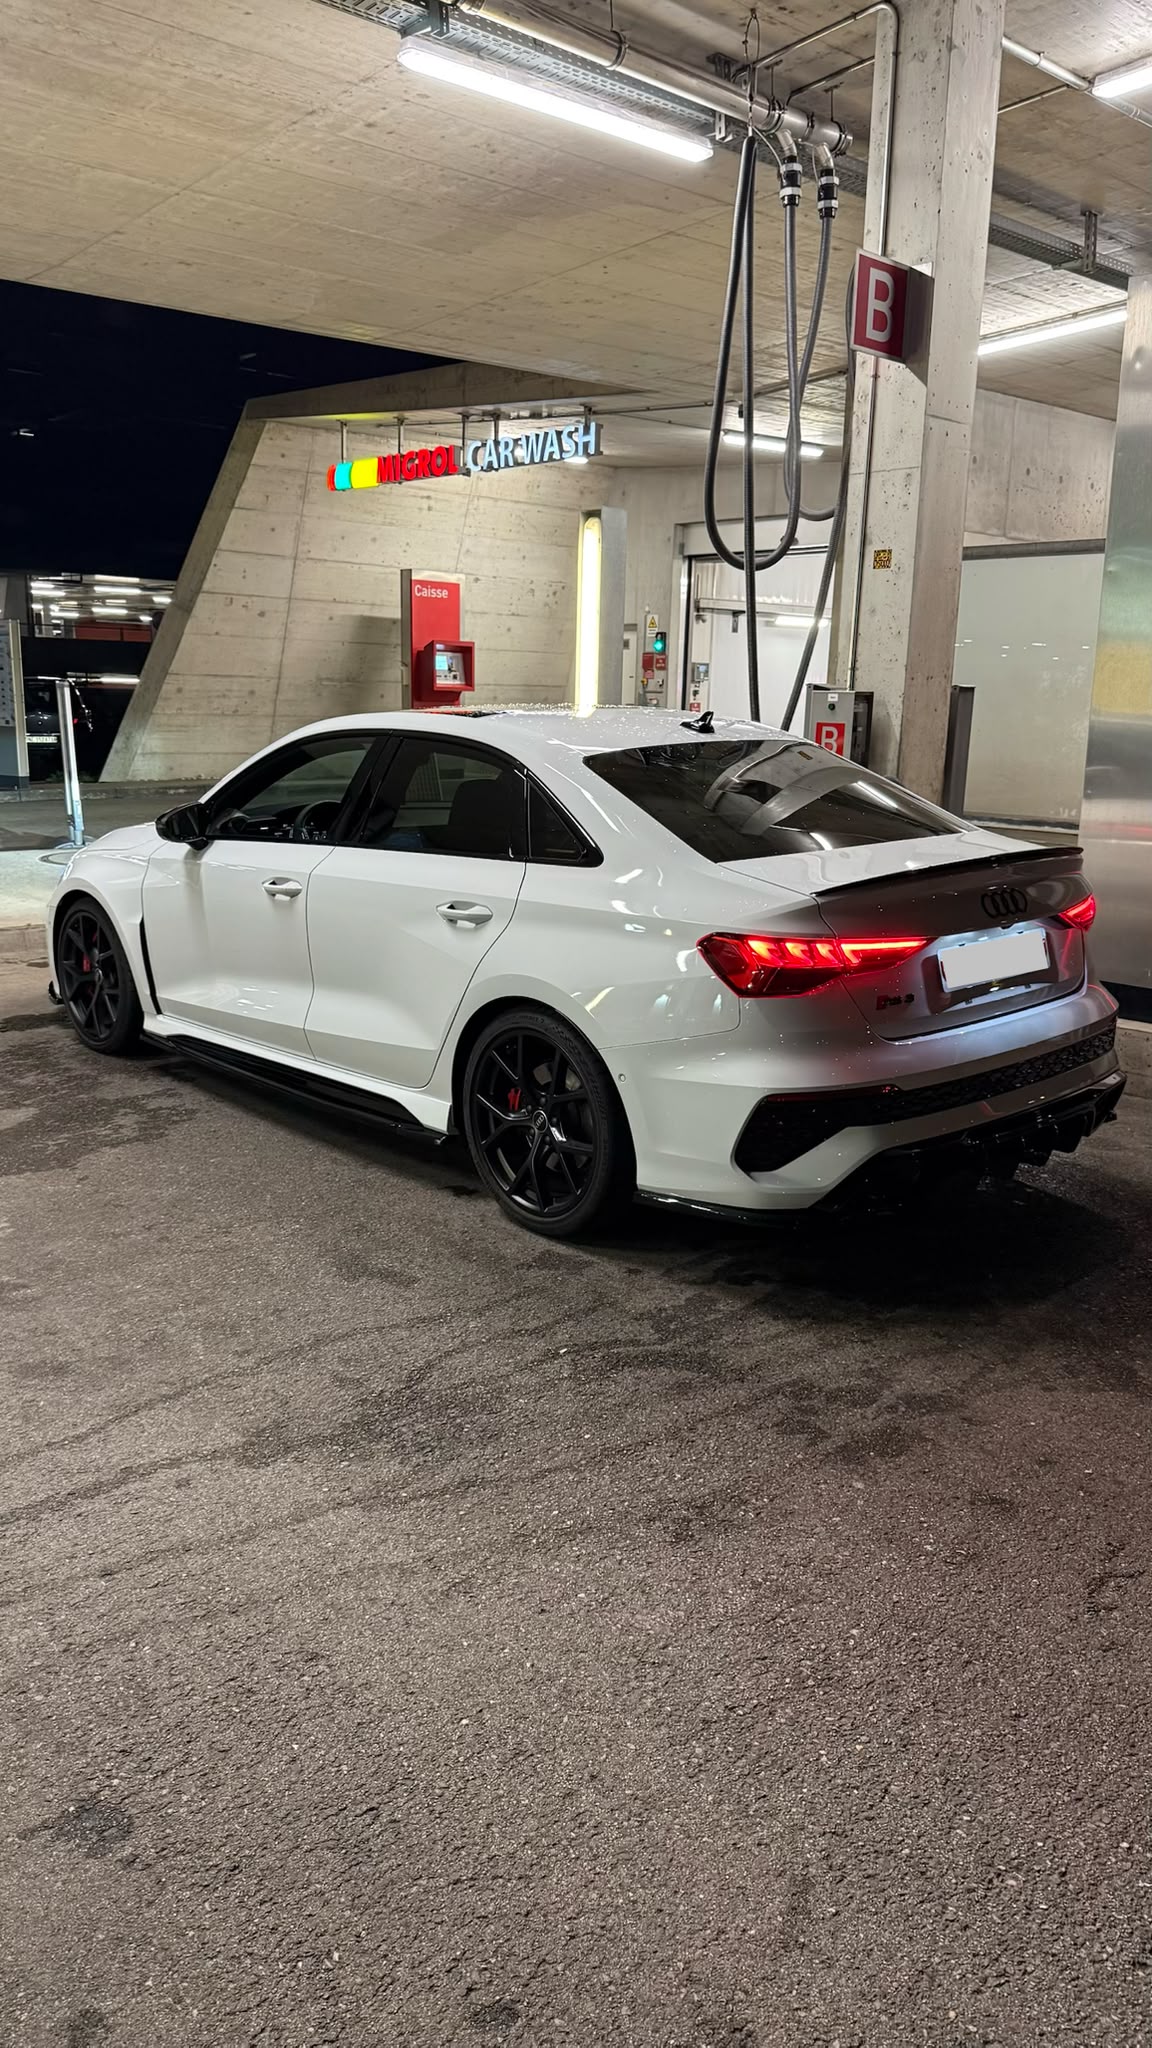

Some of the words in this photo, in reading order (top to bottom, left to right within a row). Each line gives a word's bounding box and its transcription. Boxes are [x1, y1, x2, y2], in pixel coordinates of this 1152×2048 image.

[865, 266, 896, 343] B
[376, 444, 459, 484] MIGROL
[466, 436, 514, 472] CAR
[520, 421, 597, 465] WASH
[414, 584, 449, 599] Caisse
[820, 725, 838, 754] B
